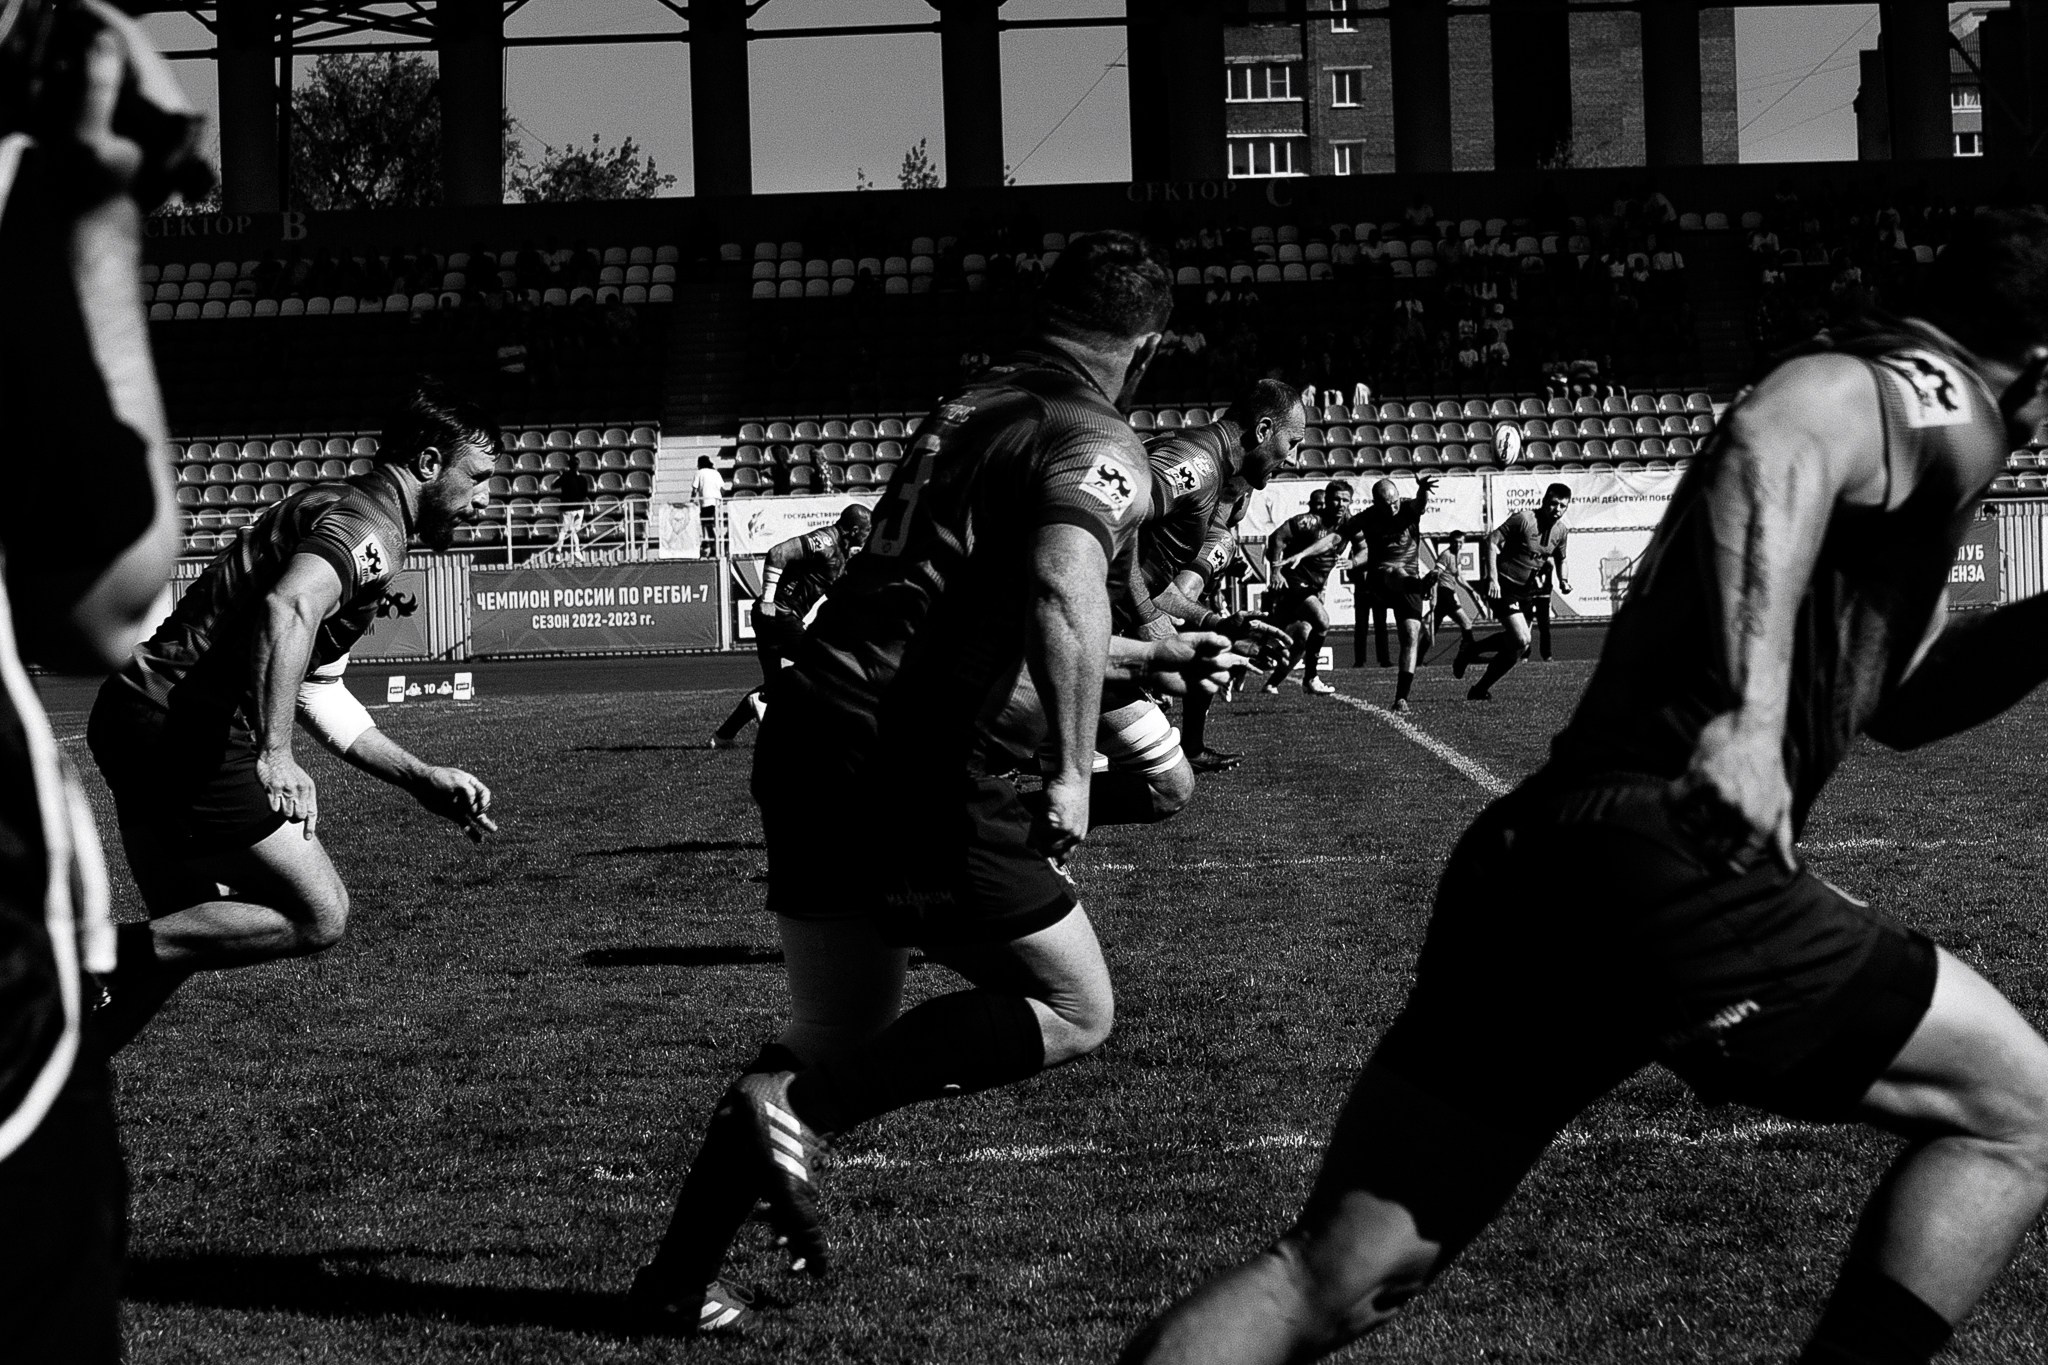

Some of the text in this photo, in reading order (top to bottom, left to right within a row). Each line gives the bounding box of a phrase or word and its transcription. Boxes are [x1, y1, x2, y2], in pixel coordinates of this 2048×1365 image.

[1506, 489, 1534, 497] СПОРТ
[1571, 496, 1600, 504] ЕЧТАЙ!
[1649, 494, 1673, 502] ПОБЕ
[1506, 498, 1541, 506] НОРМА
[1954, 544, 1985, 561] ЛУБ
[476, 584, 709, 611] ЧЕМПИОН РОССИИ ПО РЕГБИ-7
[532, 612, 655, 629] СЕЗОН 2022-2023 гг.
[424, 683, 436, 695] 10
